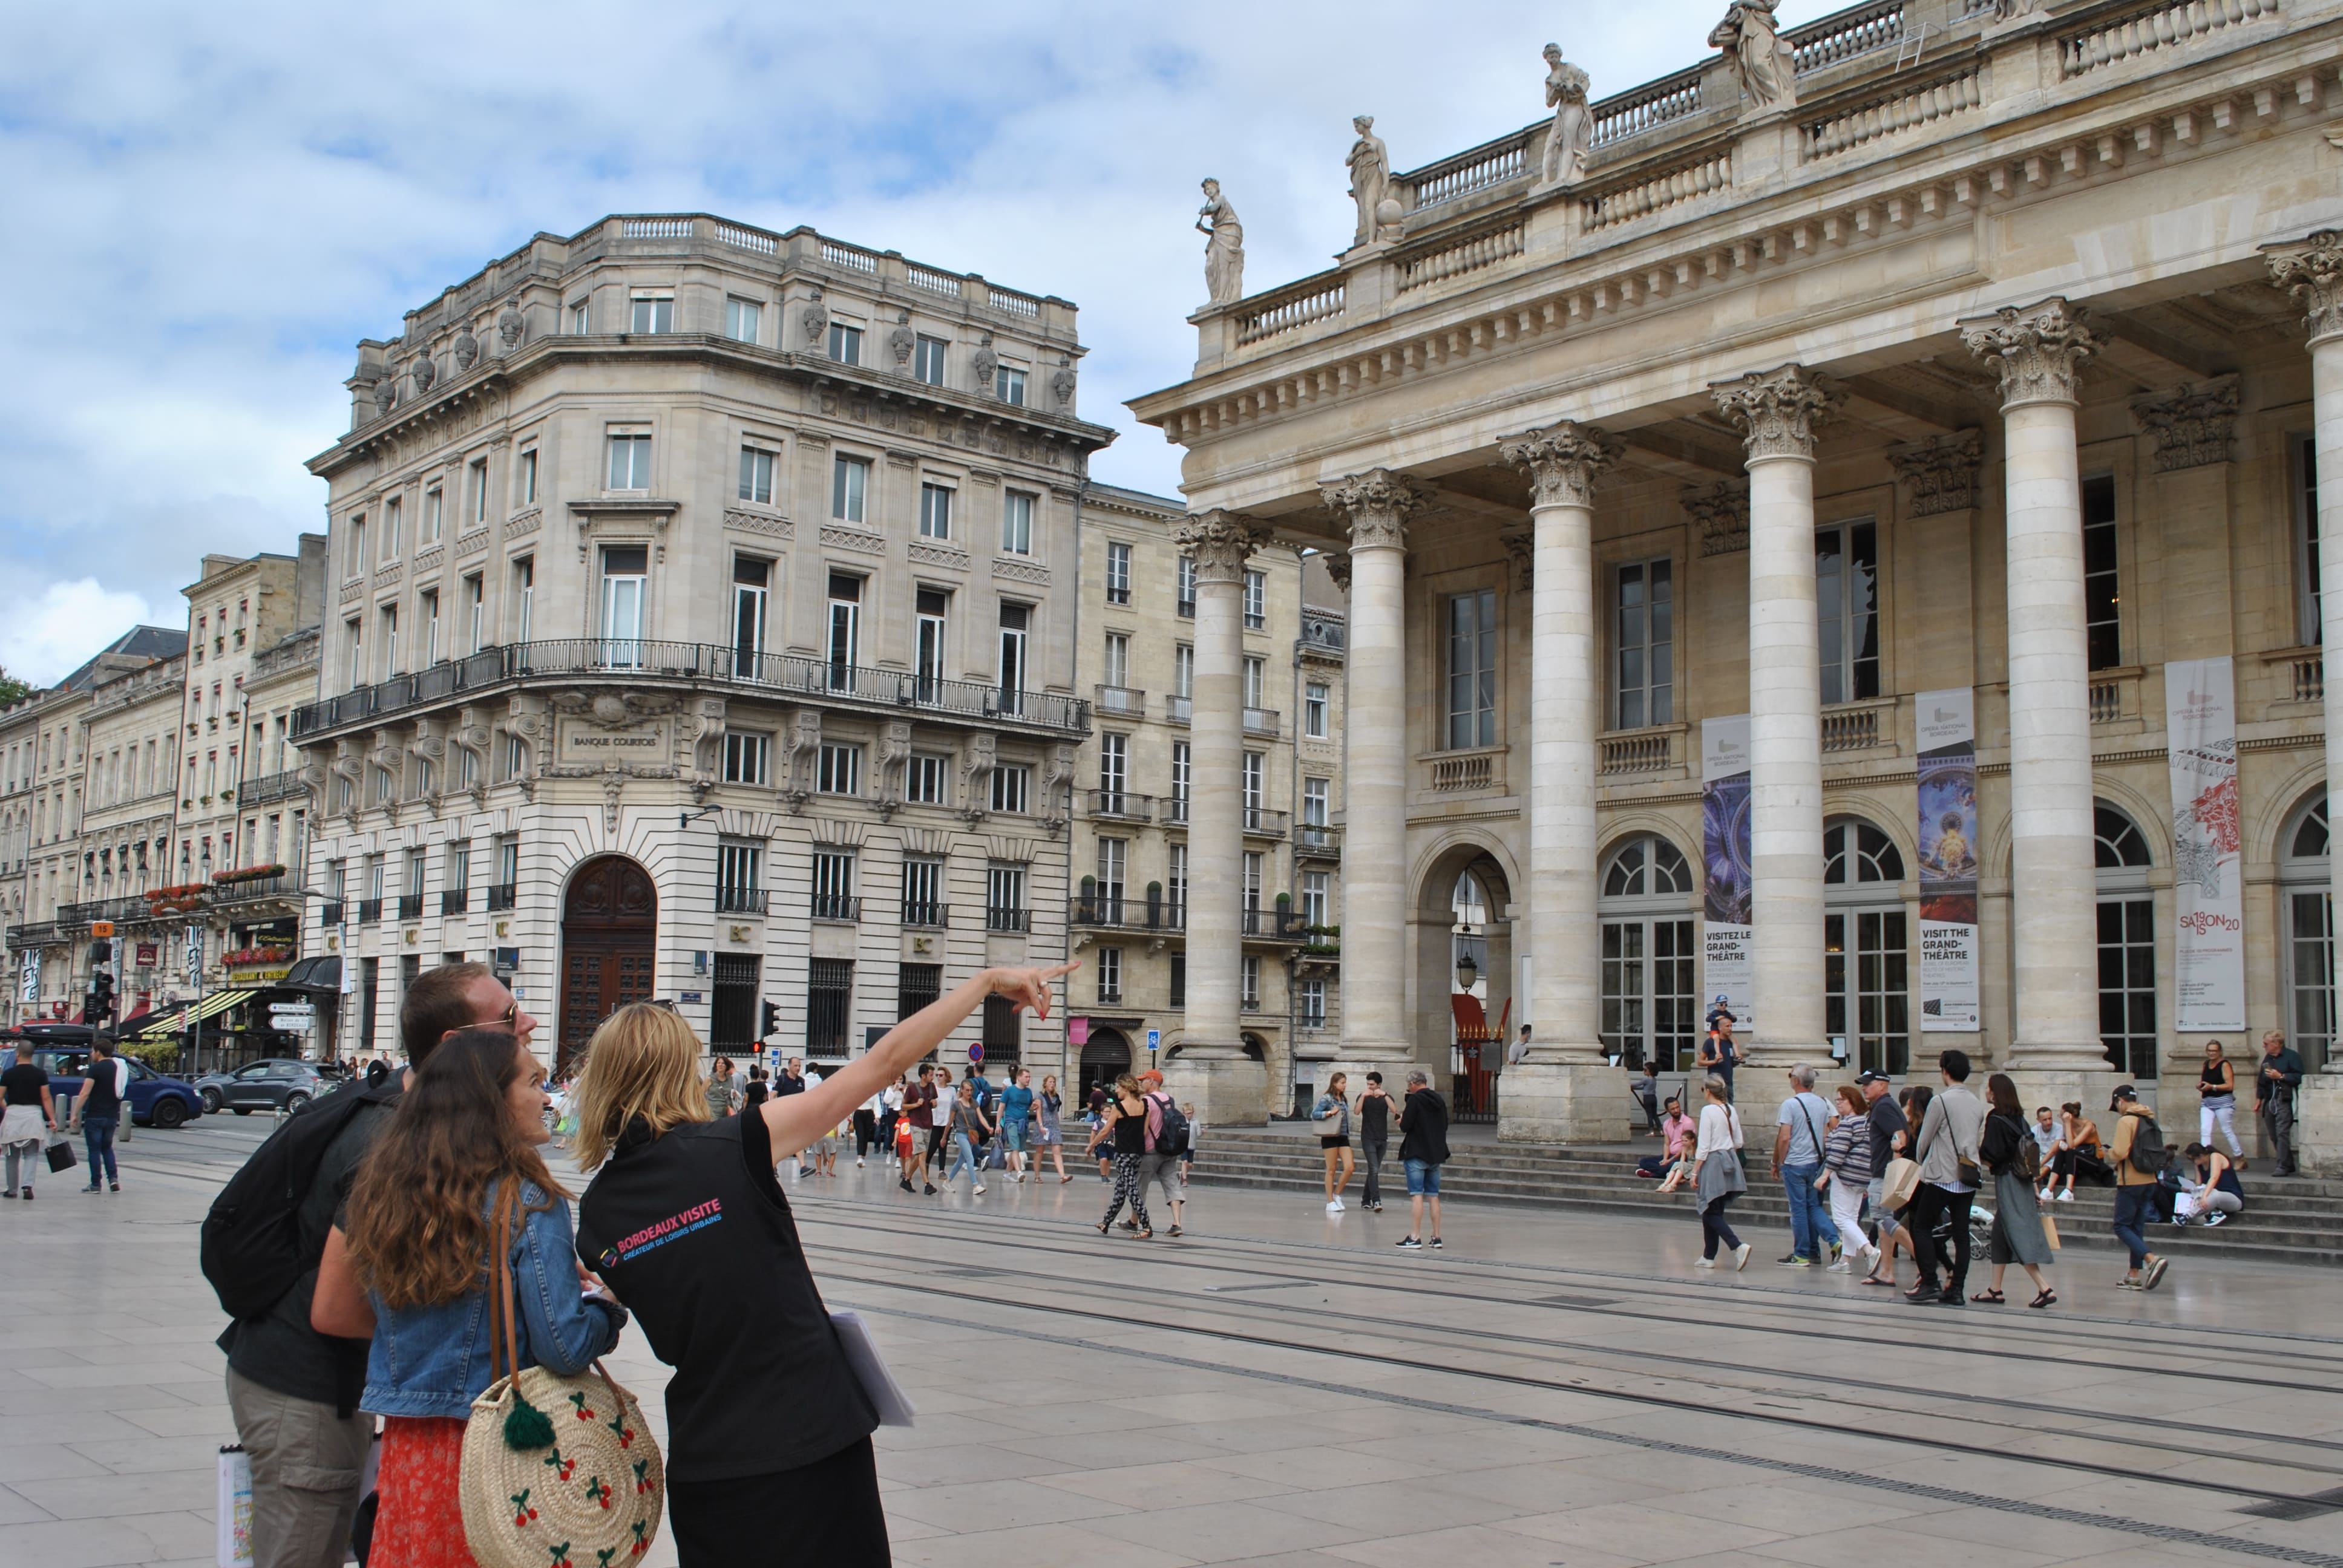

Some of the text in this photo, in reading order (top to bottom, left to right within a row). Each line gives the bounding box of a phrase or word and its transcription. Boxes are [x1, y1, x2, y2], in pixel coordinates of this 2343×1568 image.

[574, 737, 657, 748] BANQUE COURTOIS
[98, 925, 108, 933] 15
[729, 925, 751, 943] BC
[1922, 928, 1970, 938] VISIT THE
[1706, 931, 1751, 941] VISITEZ LE
[913, 937, 933, 954] BC
[1706, 942, 1741, 951] GRAND-
[1922, 940, 1962, 949] GRAND-
[1706, 950, 1746, 961] THÉÂTRE
[1922, 948, 1968, 961] THÉÂTRE
[617, 1198, 722, 1253] BORDEAUX VISITE
[623, 1214, 722, 1261] CRÉATEUR DE LOISIRS URBAINS
